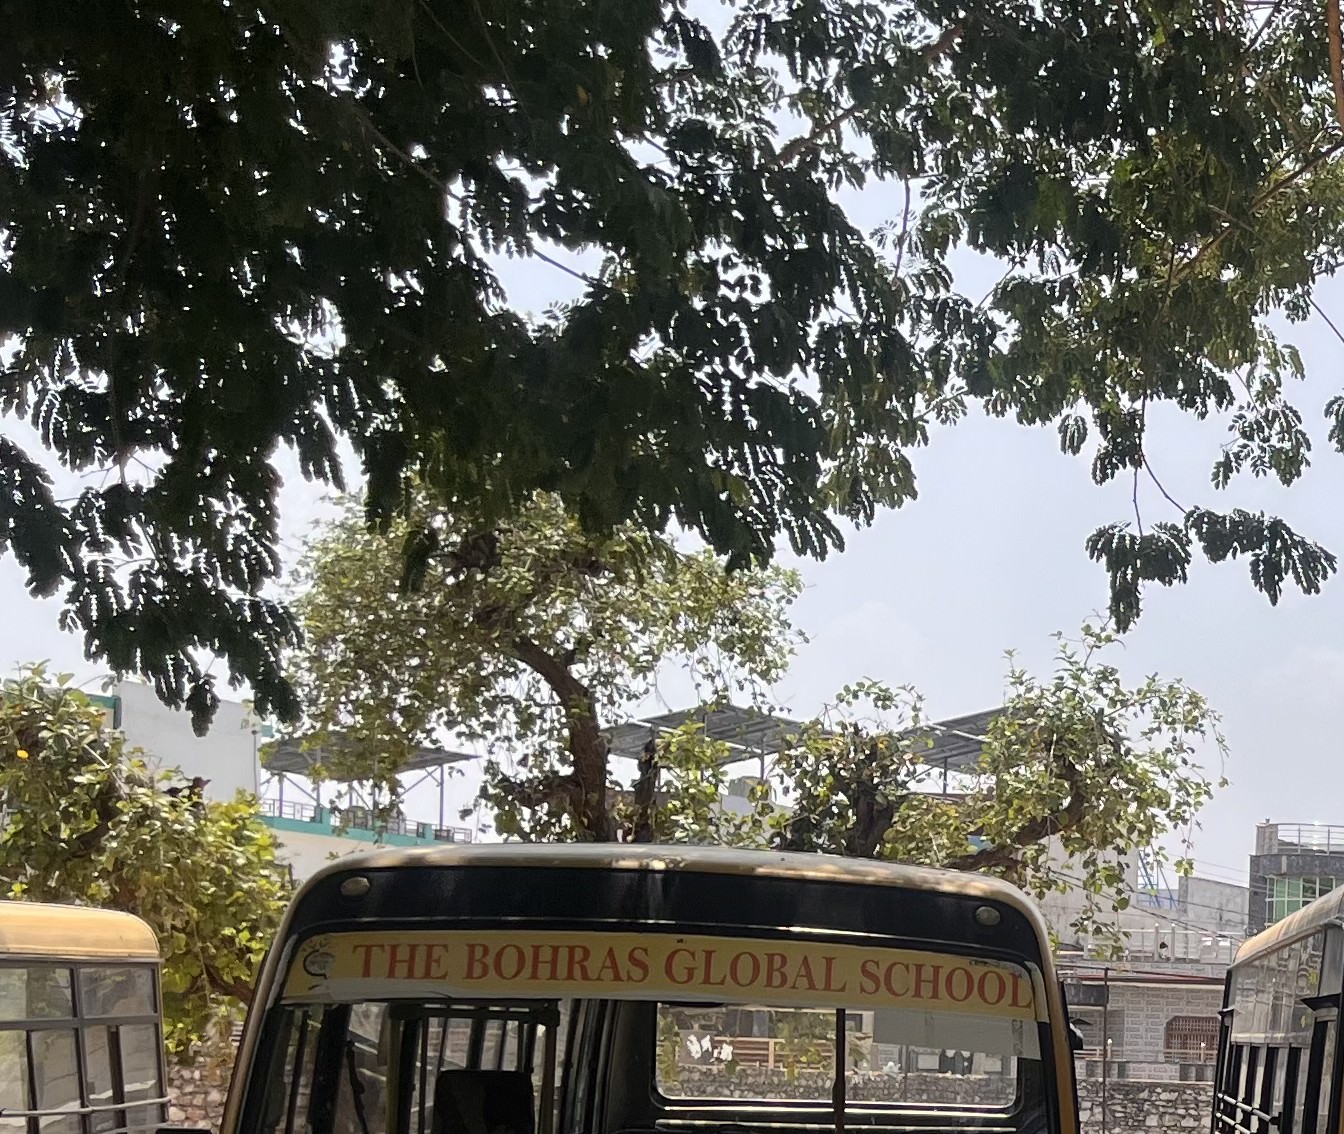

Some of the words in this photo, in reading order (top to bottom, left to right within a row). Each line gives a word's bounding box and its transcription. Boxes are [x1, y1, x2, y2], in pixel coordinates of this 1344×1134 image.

[353, 943, 449, 980] THE
[462, 943, 649, 983] BOHRAS
[664, 948, 847, 993] GLOBAL
[858, 958, 1034, 1009] SCHOOL
